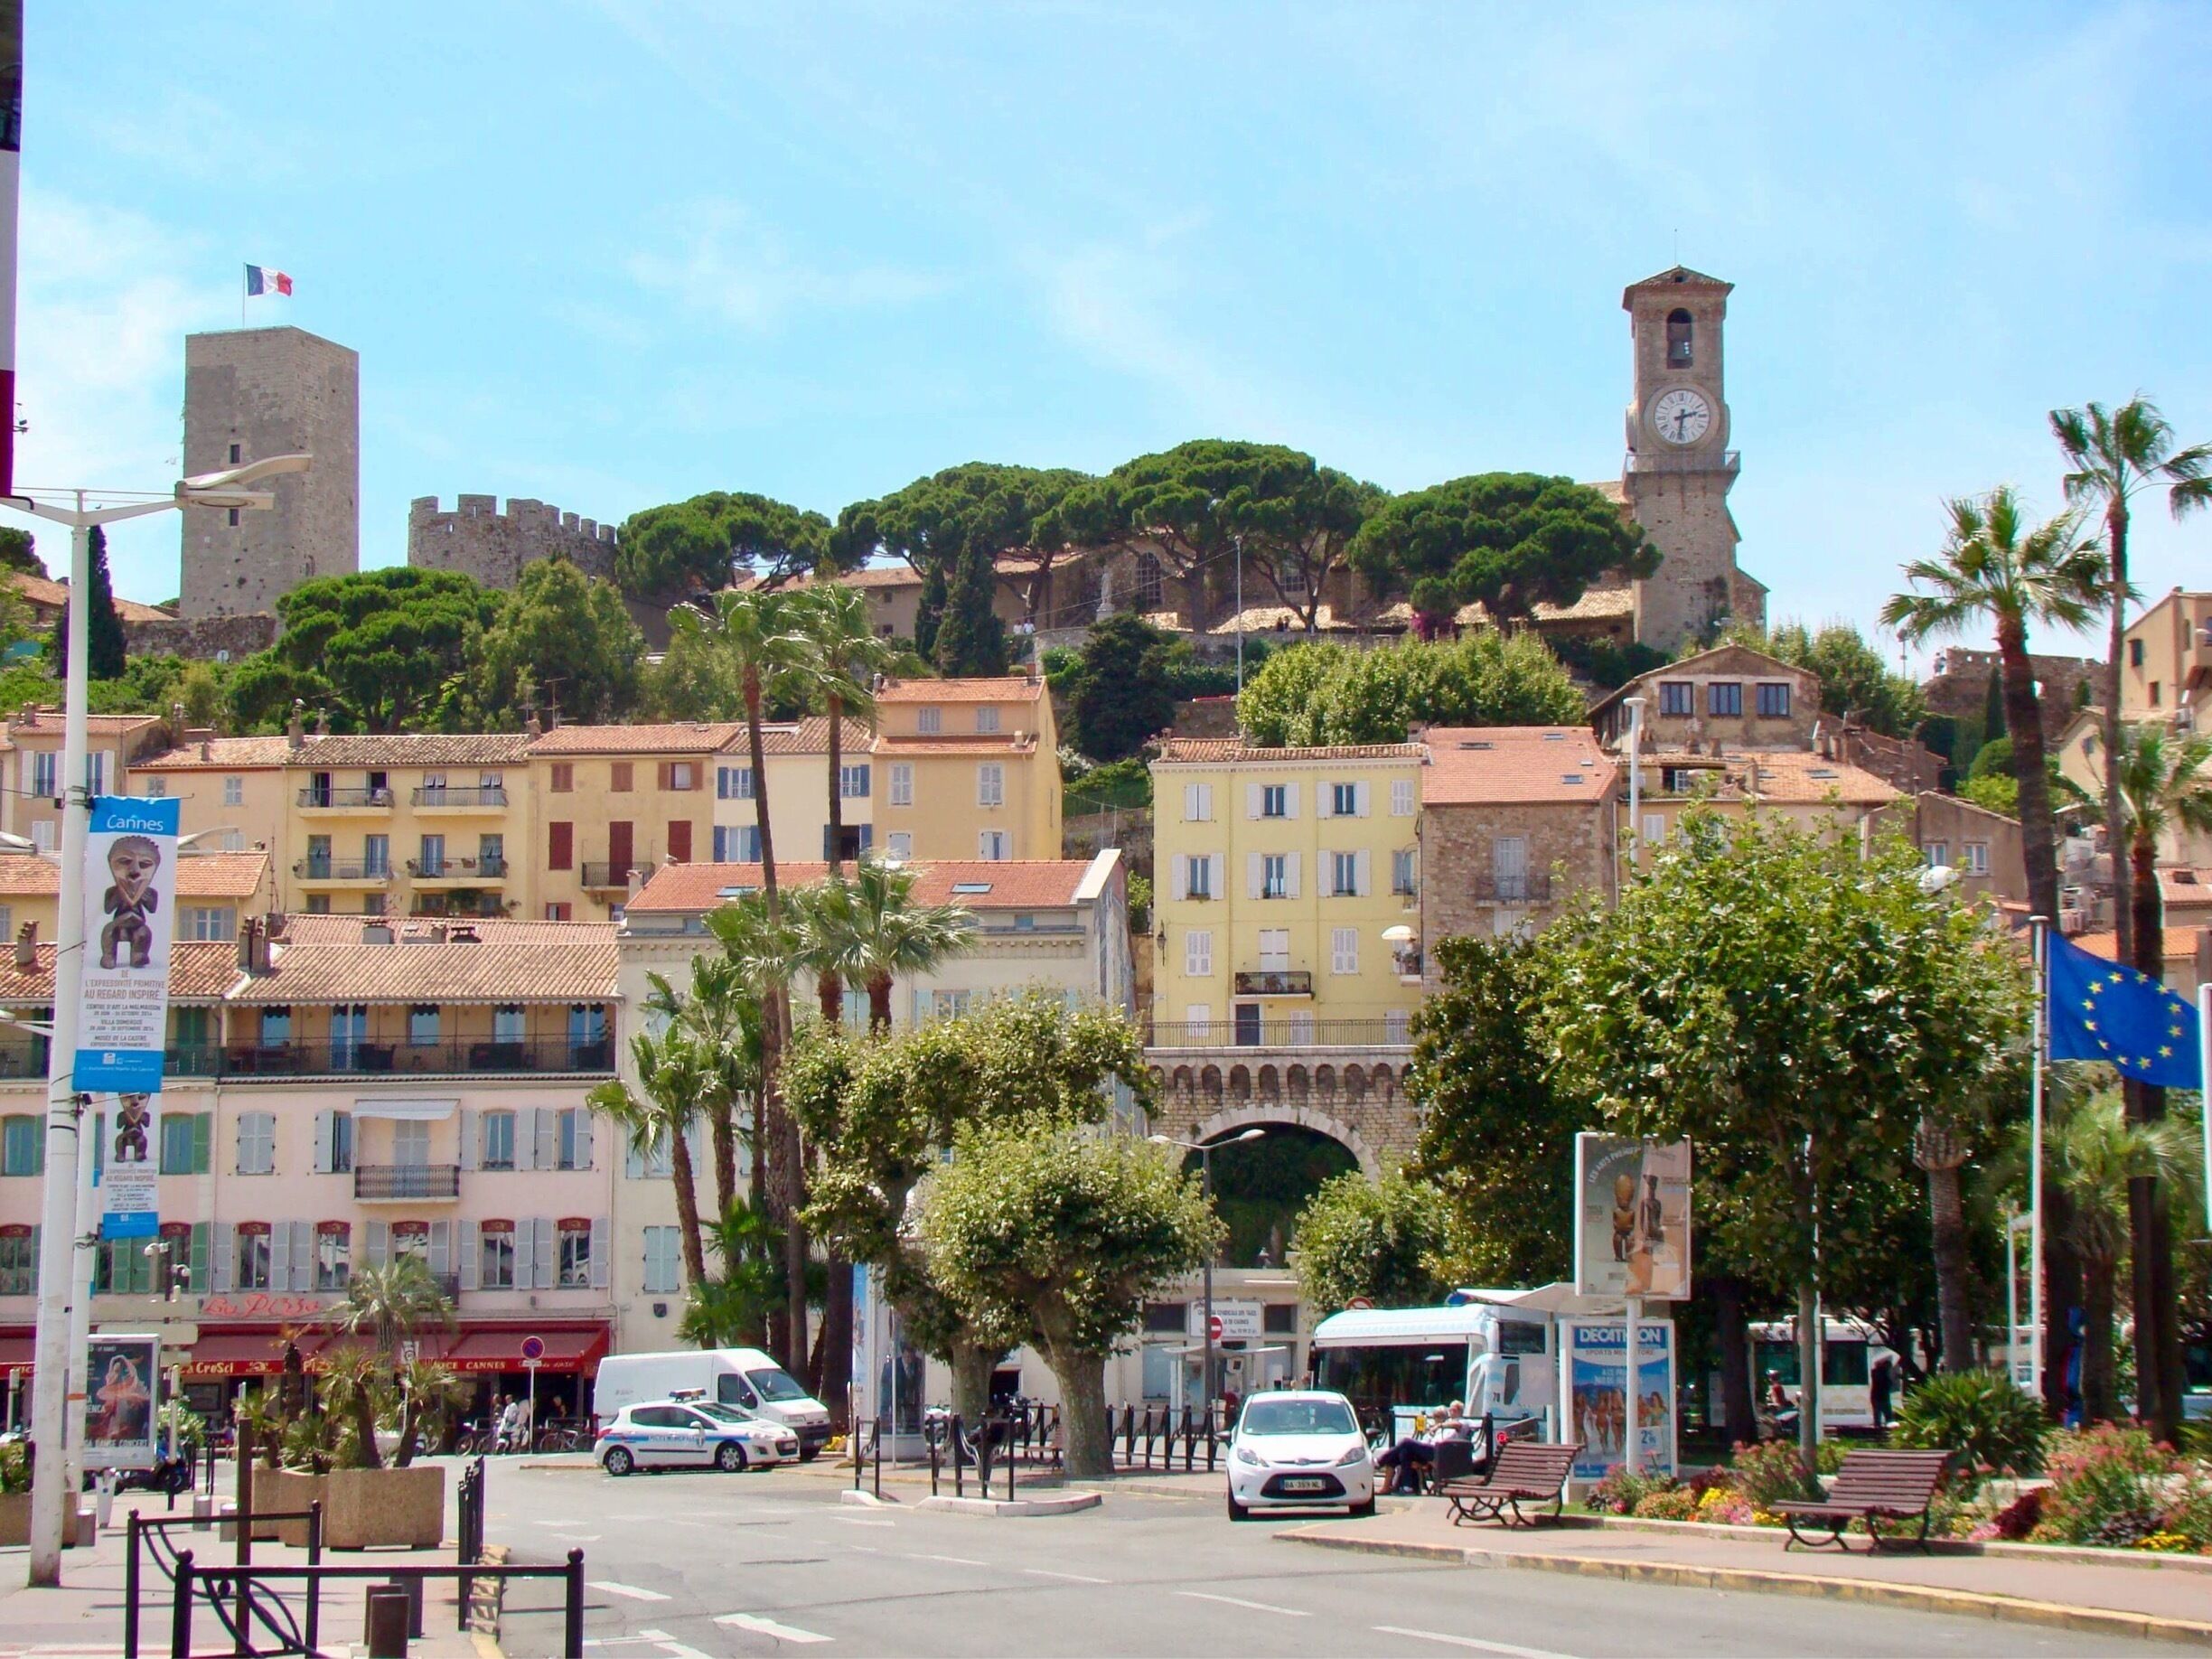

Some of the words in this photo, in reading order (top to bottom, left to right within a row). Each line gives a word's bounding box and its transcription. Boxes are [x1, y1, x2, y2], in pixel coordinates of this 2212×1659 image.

[107, 815, 164, 831] Cannes
[134, 979, 164, 989] PRIMITIVE
[84, 989, 95, 999] AU
[97, 989, 127, 999] REGARD
[466, 1361, 506, 1370] CANNES
